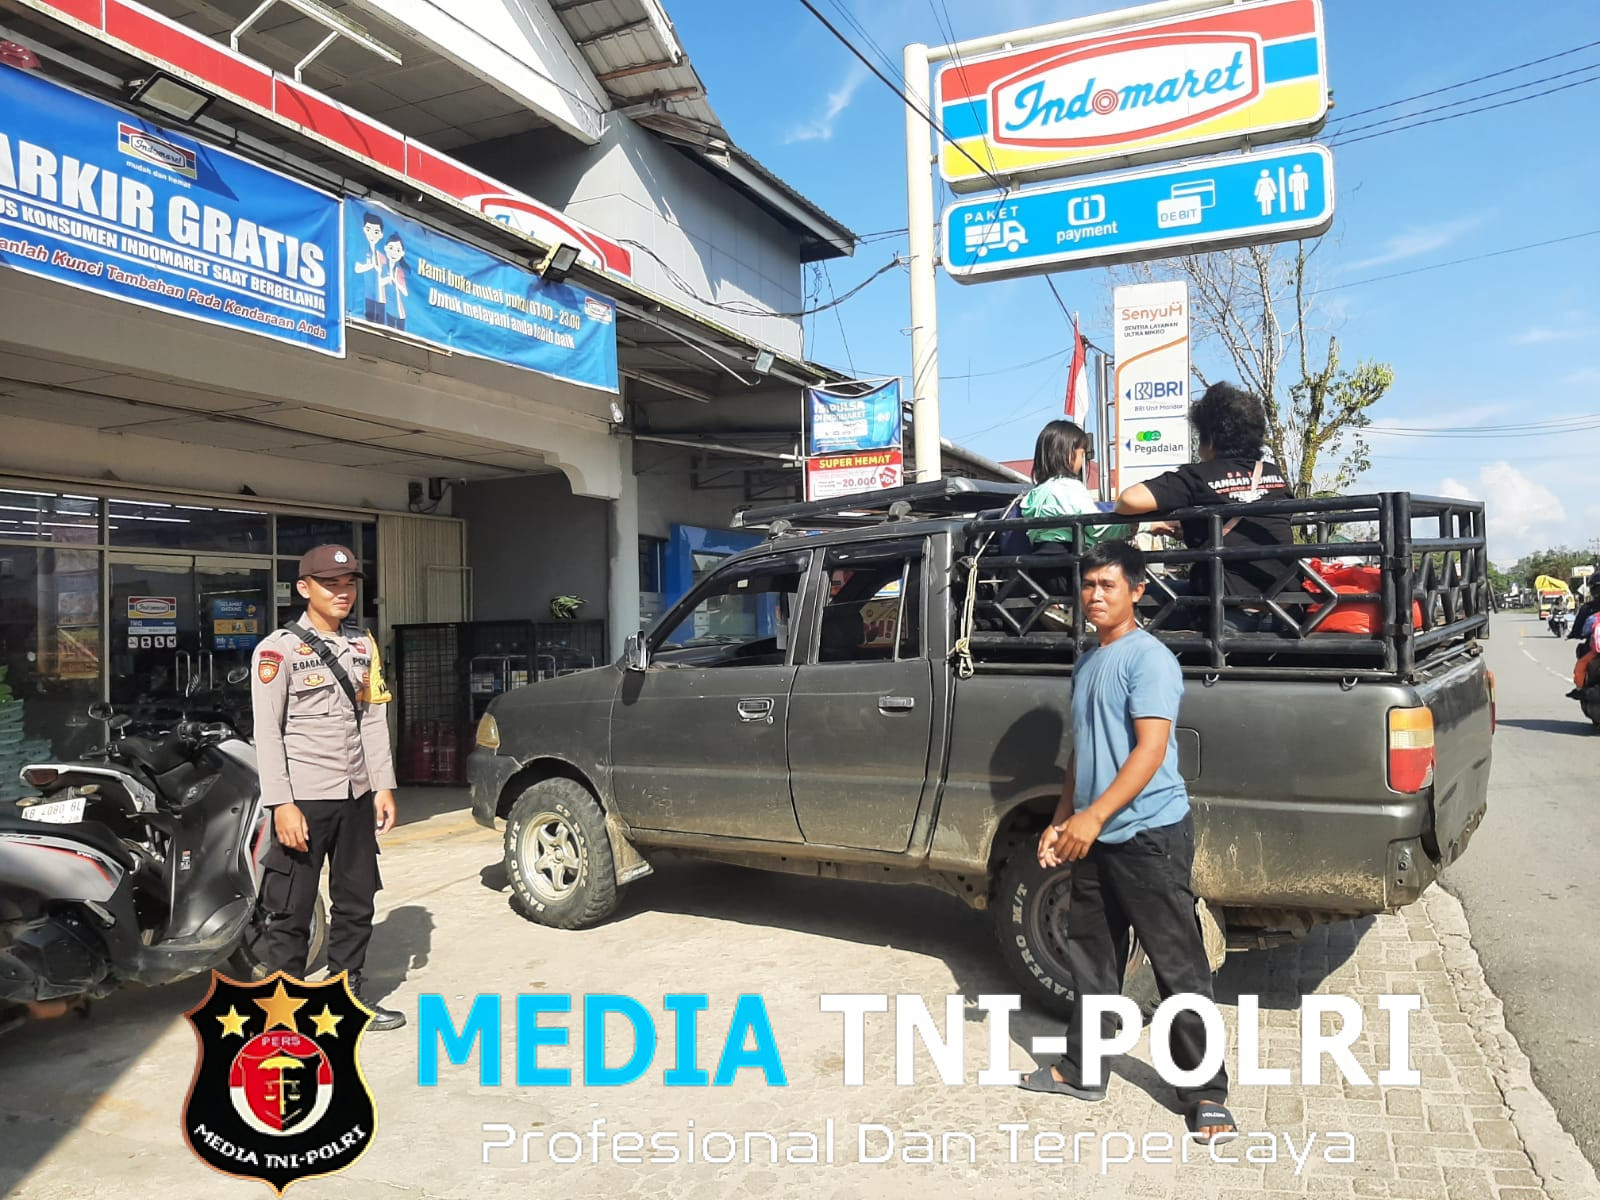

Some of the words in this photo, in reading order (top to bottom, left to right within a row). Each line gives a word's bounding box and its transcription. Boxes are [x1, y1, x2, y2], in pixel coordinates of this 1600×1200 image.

[1004, 50, 1245, 132] Indomaret
[153, 170, 167, 180] dan
[964, 205, 1018, 224] PAKET
[1056, 220, 1118, 244] payment
[1160, 208, 1198, 223] DEBIT
[22, 205, 118, 249] KONSUMEN
[121, 238, 210, 275] INDOMARET
[213, 263, 248, 287] SAAT
[251, 279, 326, 311] BERBELANJA
[168, 196, 326, 288] GRATIS
[52, 251, 103, 276] Kunci
[106, 266, 184, 299] Tambahan
[187, 290, 221, 309] Pada
[224, 301, 294, 330] Kendaraan
[297, 319, 327, 339] Anda
[418, 258, 446, 283] Kami
[559, 310, 580, 330] 23.00
[429, 287, 462, 314] Untuk
[511, 317, 533, 336] anda
[1154, 381, 1183, 397] BRI
[819, 458, 852, 469] SUPER
[855, 454, 891, 466] HEMAT
[1135, 443, 1183, 455] Pegadaian
[842, 477, 876, 488] 20.000
[510, 821, 520, 852] M/T
[511, 859, 546, 912] SAVERO
[1012, 883, 1028, 924] M/T
[1016, 934, 1075, 1001] SAVERO
